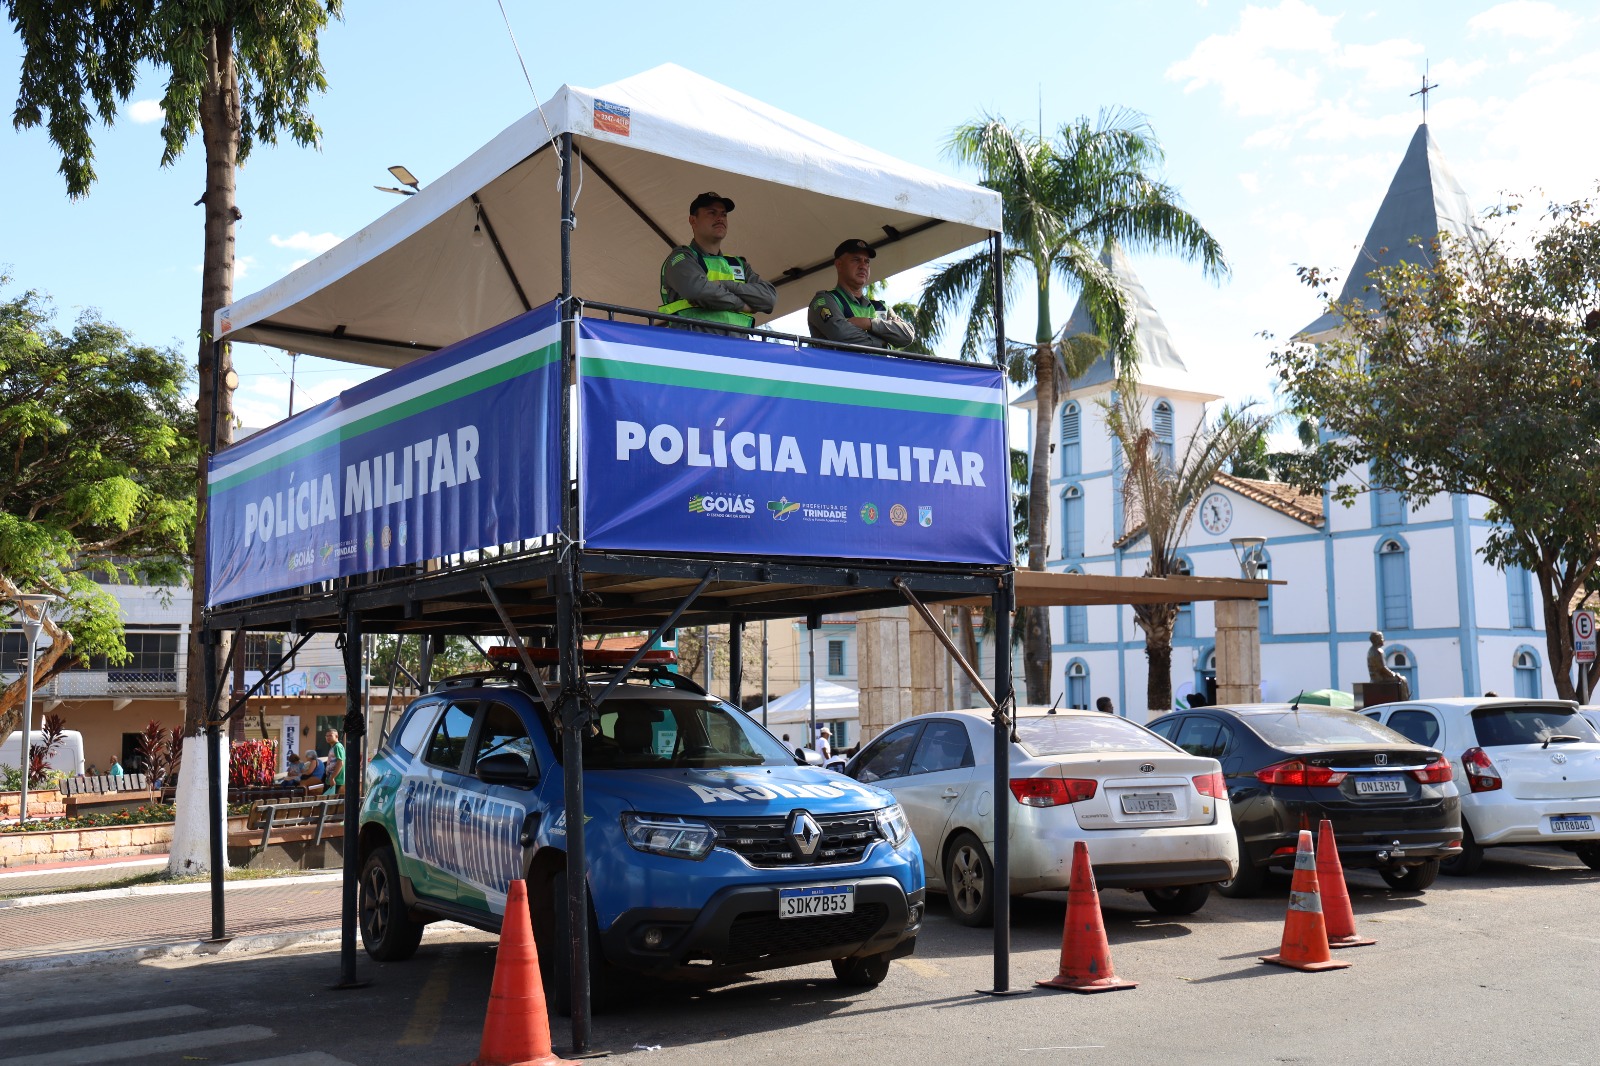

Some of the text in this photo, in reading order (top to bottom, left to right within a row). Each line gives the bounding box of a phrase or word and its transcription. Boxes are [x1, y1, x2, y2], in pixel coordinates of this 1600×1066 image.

[615, 417, 987, 488] POLÍCIA MILITAR
[244, 424, 482, 547] POLÍCIA MILITAR
[701, 494, 755, 514] GOIÁS
[803, 508, 847, 519] TRINDADE
[294, 546, 315, 569] GOIÁS
[1580, 617, 1588, 634] E
[1142, 763, 1154, 772] KIA
[1361, 781, 1401, 792] ONI3H37
[403, 780, 461, 876] POLÍCIA
[787, 894, 847, 915] SDK7B53
